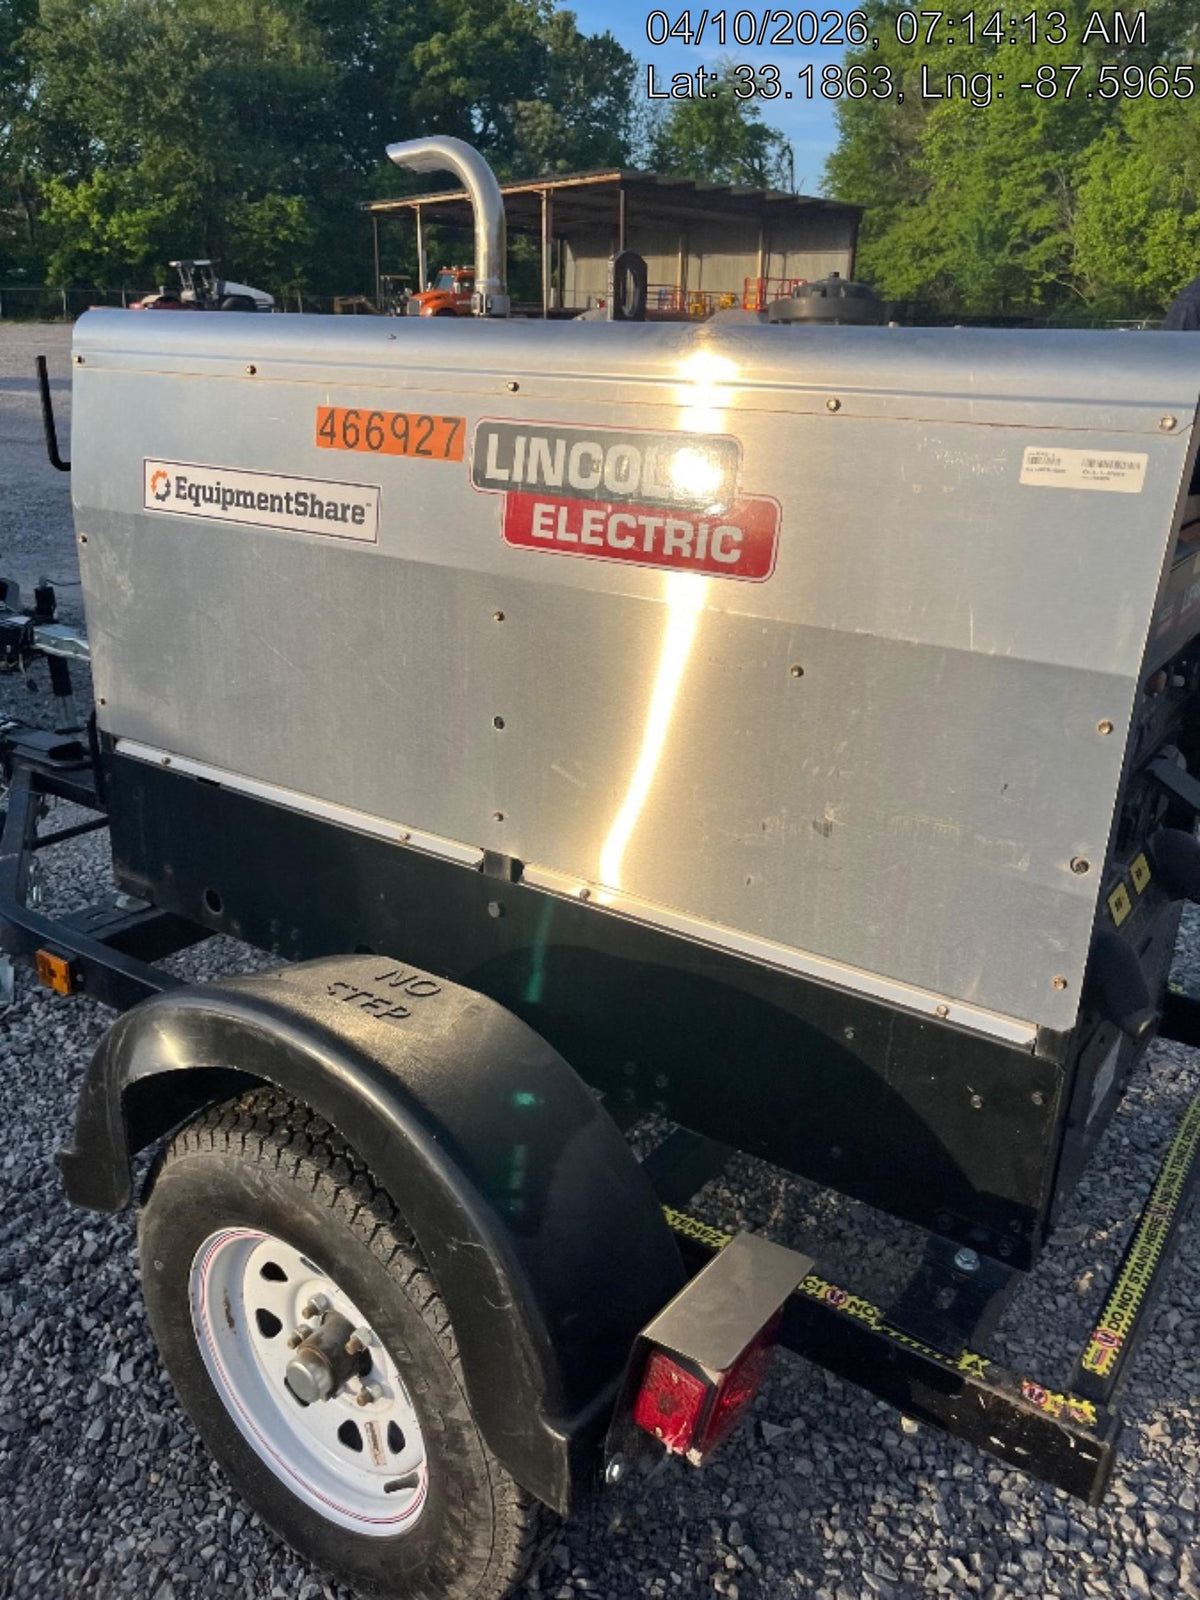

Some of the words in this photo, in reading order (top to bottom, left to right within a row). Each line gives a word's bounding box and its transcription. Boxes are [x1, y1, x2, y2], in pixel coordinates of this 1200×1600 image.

[318, 408, 464, 459] 466927
[484, 432, 730, 503] LINCOL
[530, 502, 744, 565] ELECTRIC
[326, 980, 412, 1019] STEP
[374, 969, 442, 998] NO
[671, 1213, 725, 1241] TENEZ
[1107, 1310, 1125, 1332] DO
[1116, 1283, 1136, 1311] NOT
[1127, 1245, 1152, 1284] STAND
[1143, 1216, 1164, 1247] HERE
[847, 1300, 877, 1319] NO
